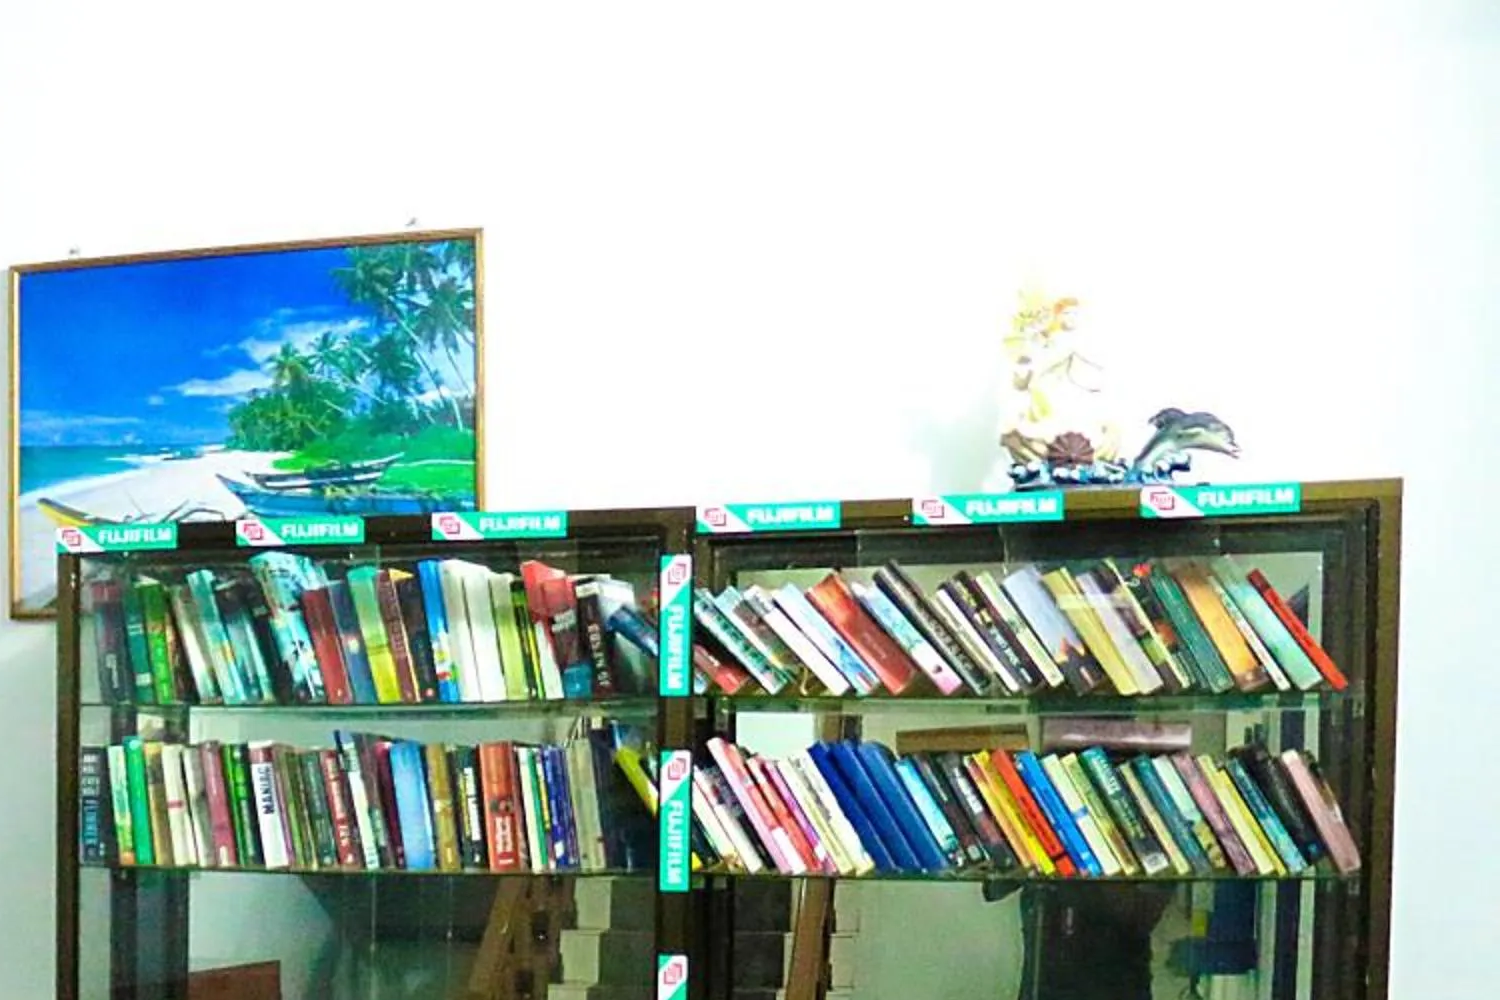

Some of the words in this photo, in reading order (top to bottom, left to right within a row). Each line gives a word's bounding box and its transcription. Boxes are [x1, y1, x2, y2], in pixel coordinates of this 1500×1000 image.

[965, 496, 1058, 516] FUJIFILM
[1196, 486, 1295, 507] FUJIFILM
[479, 515, 562, 532] FUJIFILM
[746, 505, 835, 525] FUJIFILM
[98, 527, 173, 544] FUJIFILM
[280, 522, 359, 539] FUJIFILM
[666, 605, 685, 690] FUJIFILM
[666, 799, 684, 885] FUJIFILM
